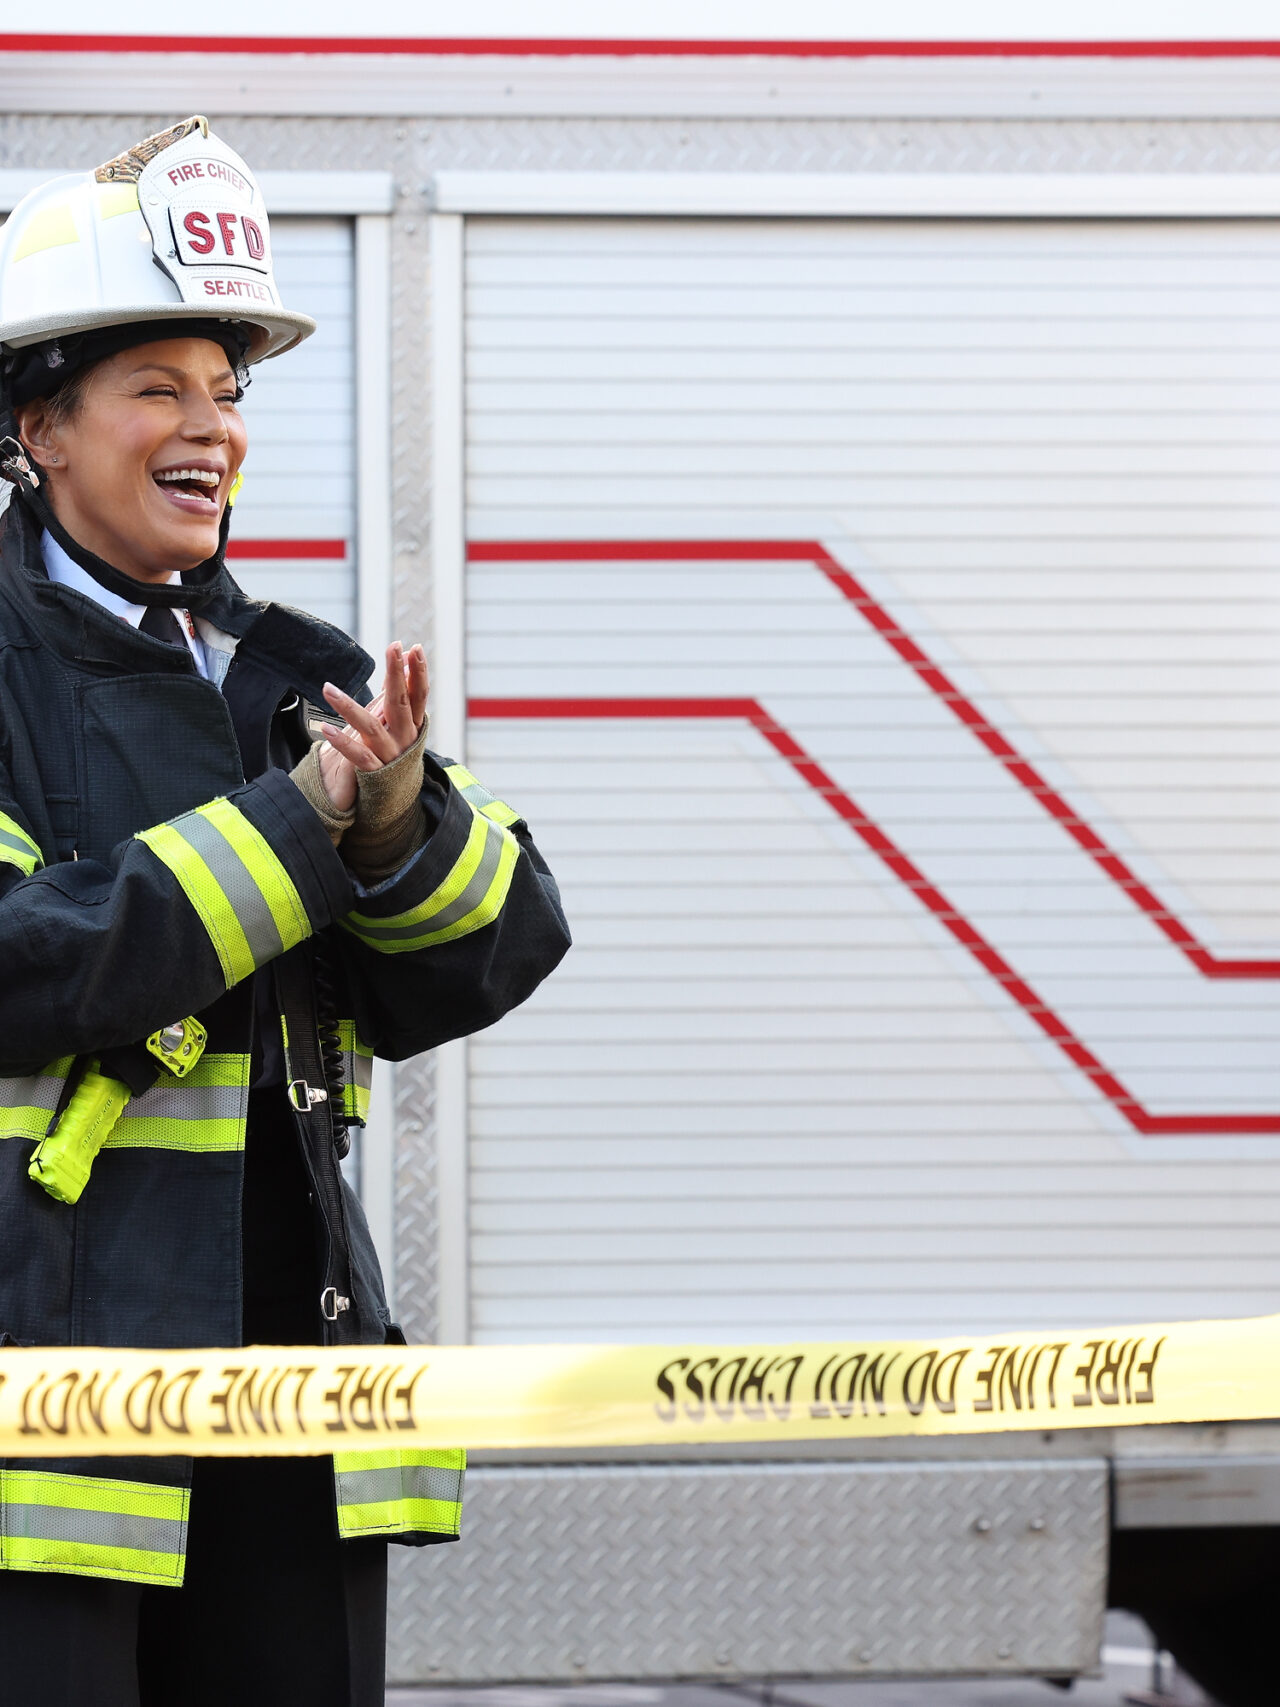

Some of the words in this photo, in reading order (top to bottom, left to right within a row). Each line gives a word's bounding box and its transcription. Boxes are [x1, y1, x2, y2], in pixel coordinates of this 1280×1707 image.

[167, 162, 205, 186] FIRE
[207, 163, 245, 191] CHIEF
[183, 211, 265, 261] SFD
[203, 280, 267, 301] SEATTLE
[18, 1371, 121, 1435] NOT
[125, 1369, 202, 1435] DO
[210, 1367, 317, 1435] LINE
[324, 1365, 428, 1433] FIRE
[655, 1356, 804, 1424] CROSS
[809, 1353, 902, 1419] NOT
[902, 1349, 971, 1416] DO
[973, 1344, 1070, 1412] LINE
[1072, 1336, 1167, 1408] FIRE
